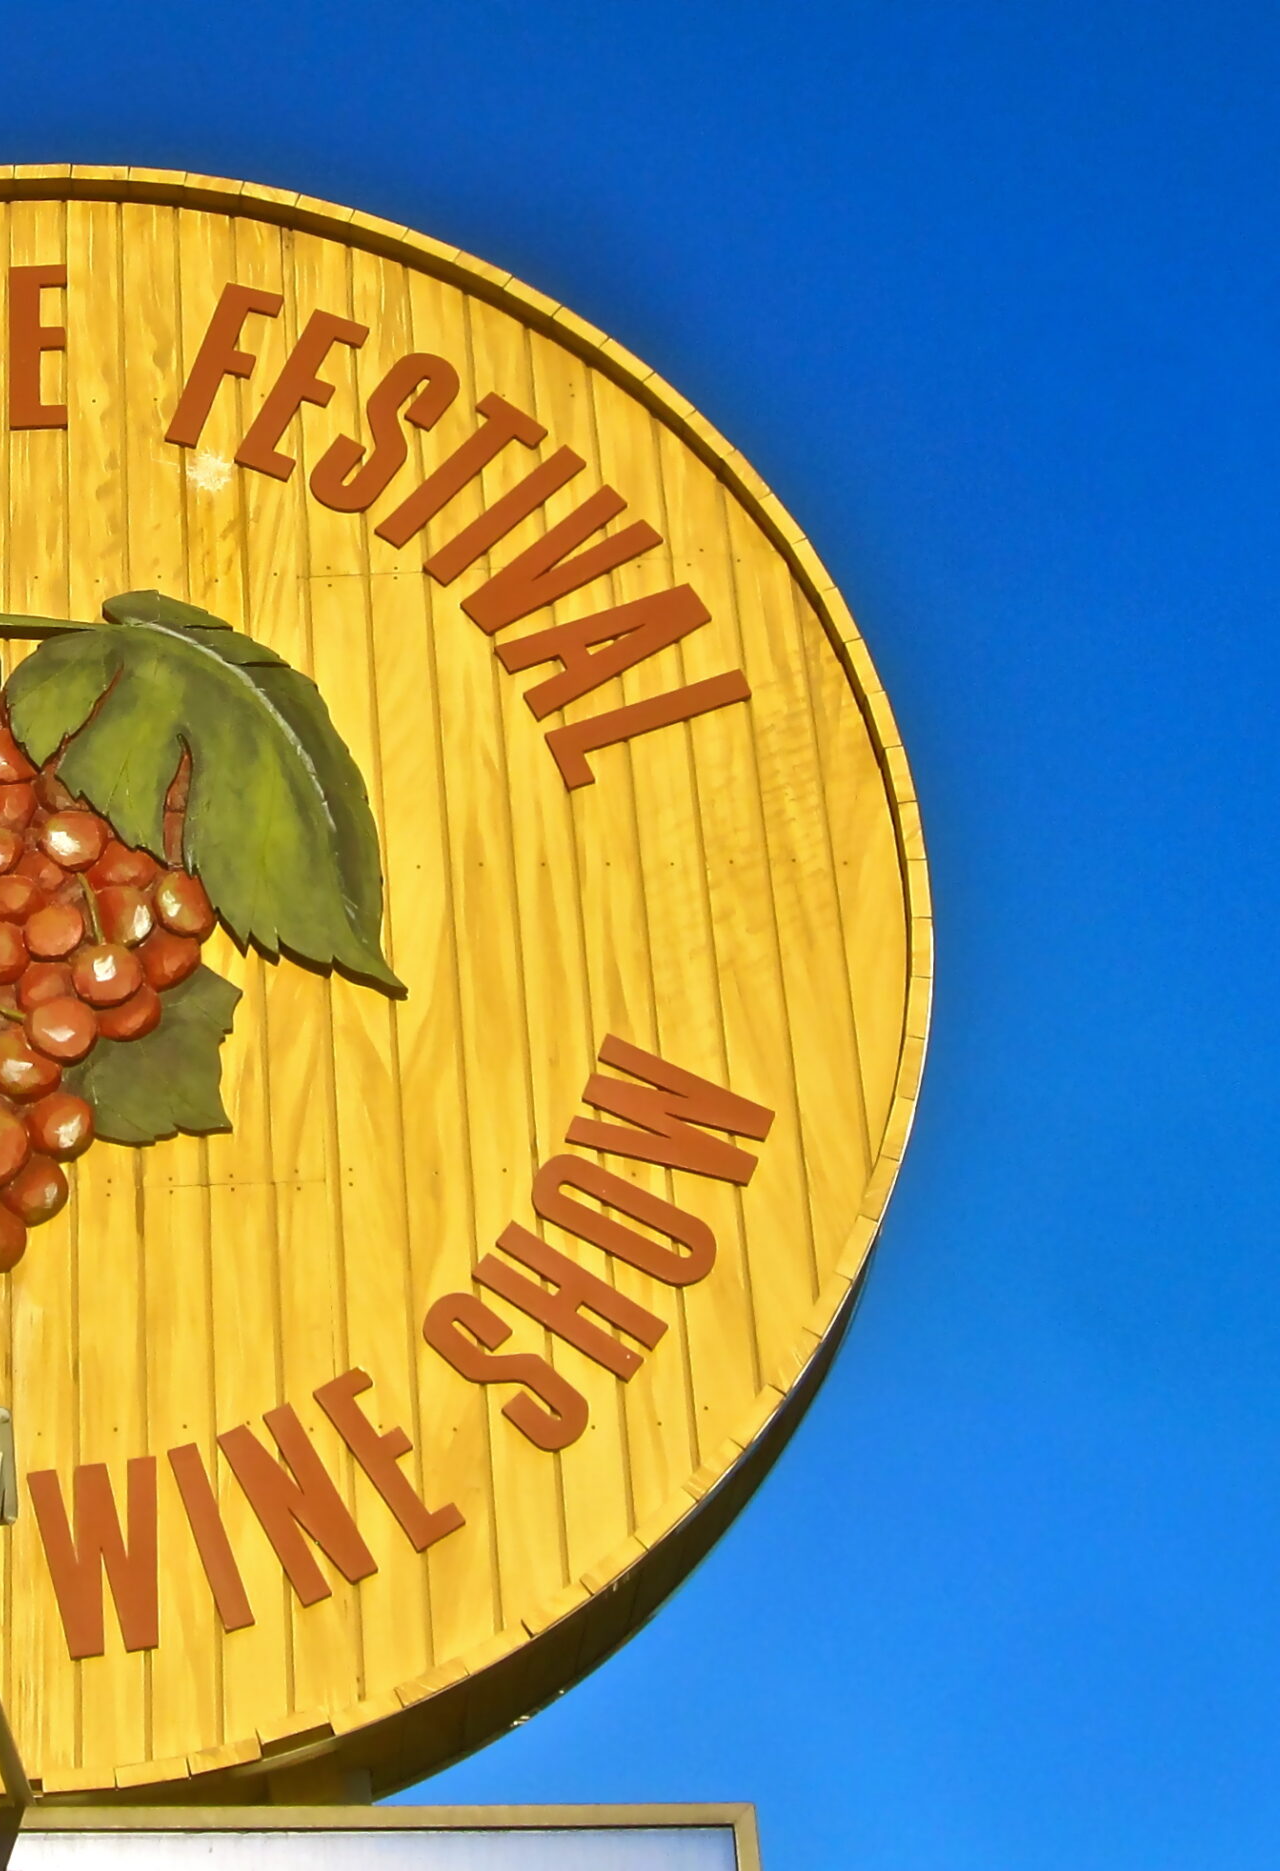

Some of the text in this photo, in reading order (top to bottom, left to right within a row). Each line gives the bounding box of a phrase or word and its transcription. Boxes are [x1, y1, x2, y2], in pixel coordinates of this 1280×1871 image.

[167, 284, 751, 789] FESTIVAL
[26, 1367, 464, 1659] WINE
[422, 1033, 773, 1450] SHOW
